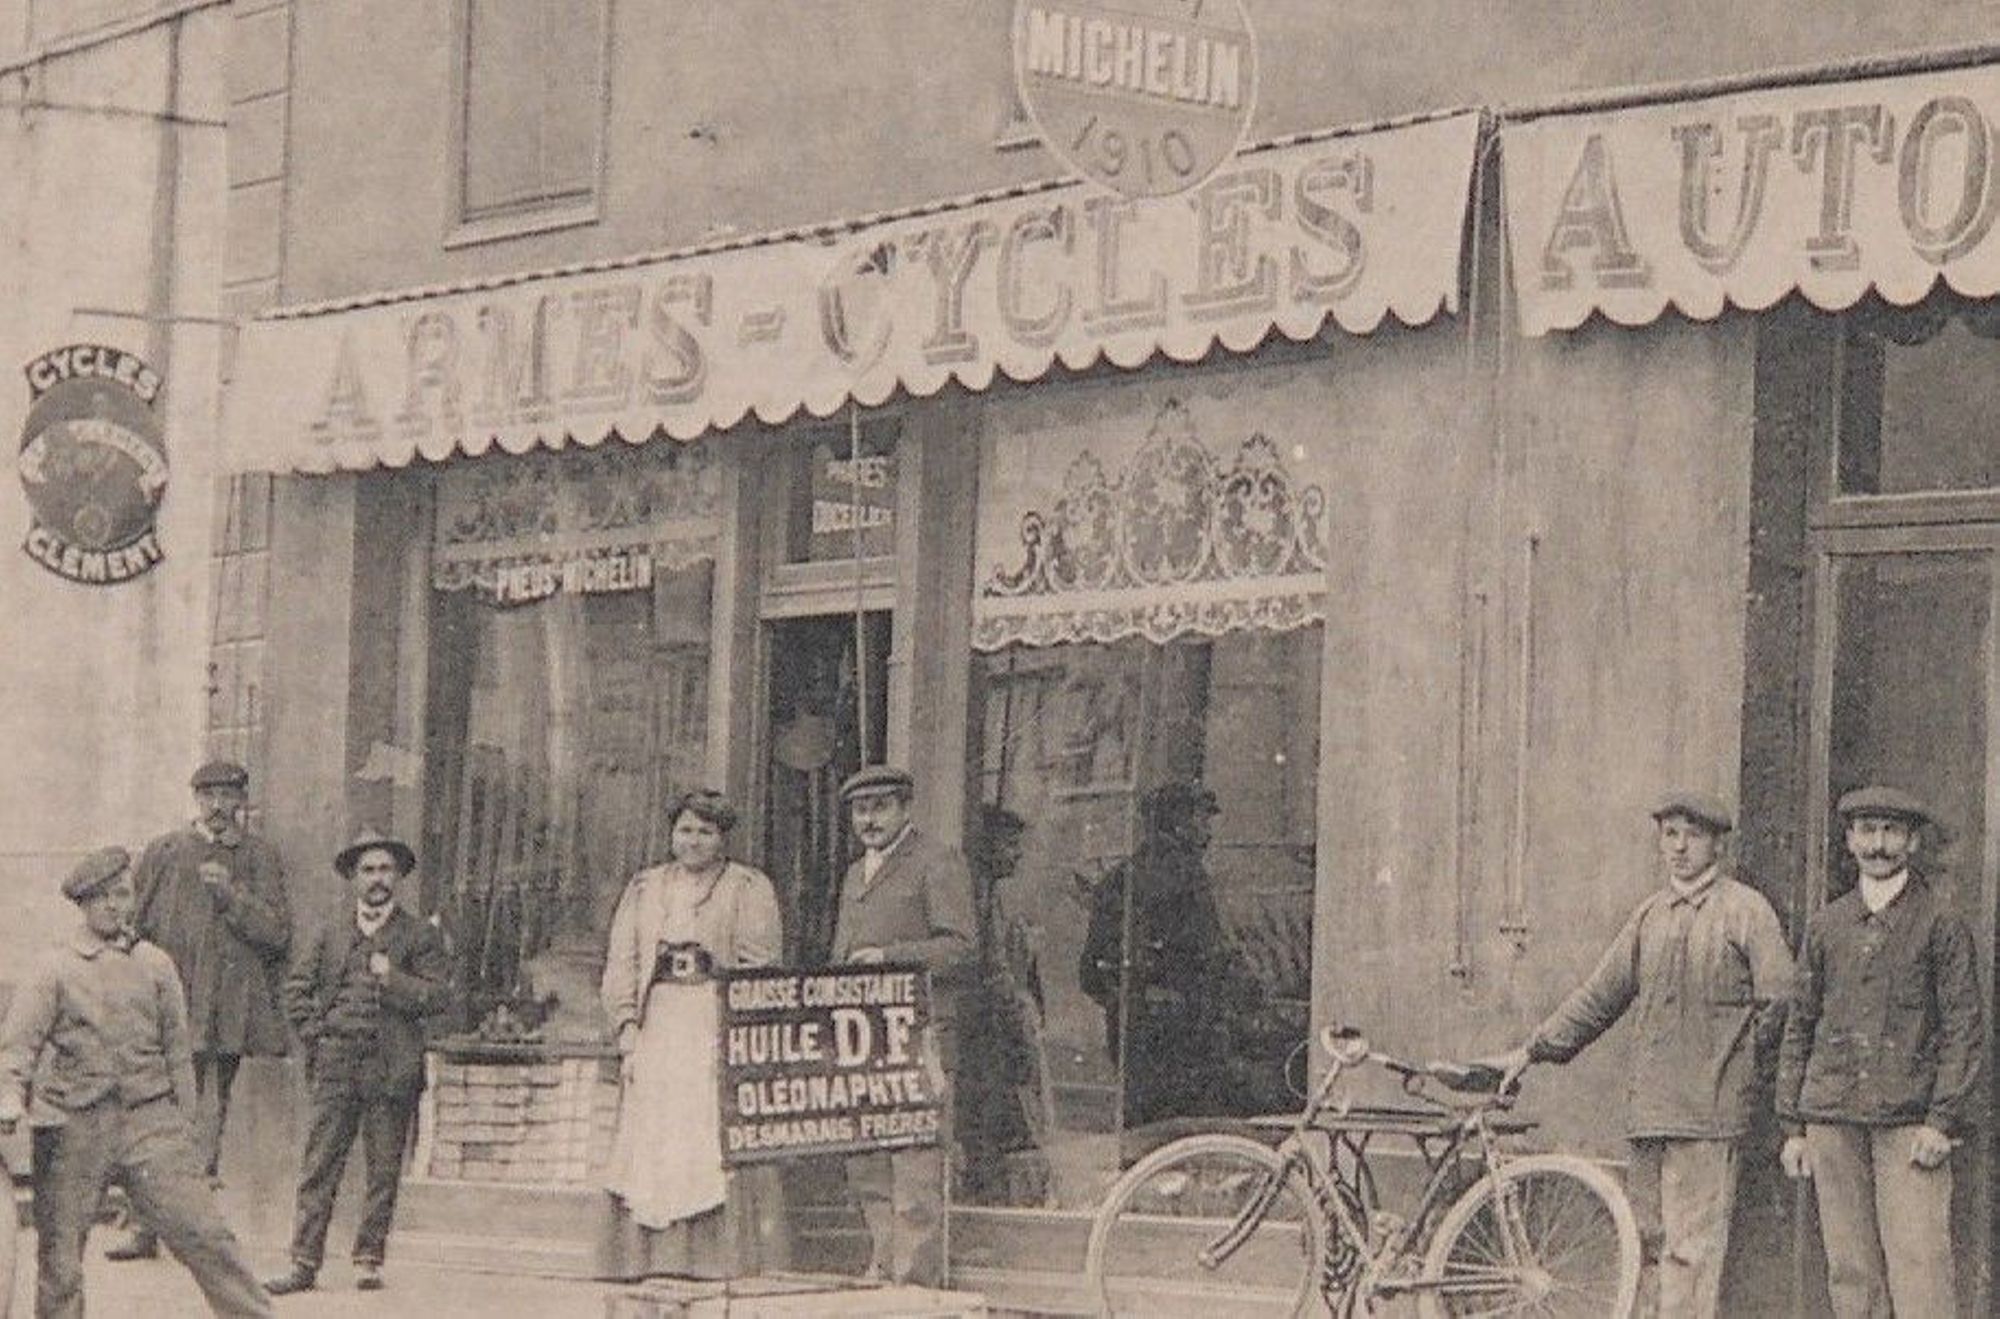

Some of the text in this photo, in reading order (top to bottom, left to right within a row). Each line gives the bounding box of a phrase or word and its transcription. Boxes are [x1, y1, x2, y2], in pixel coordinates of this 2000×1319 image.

[1027, 8, 1241, 109] MICHELIN
[1071, 115, 1196, 187] 1910
[817, 152, 1374, 384] CYCLES
[28, 347, 159, 401] CYCLES
[563, 555, 651, 592] MICHELIN
[728, 972, 916, 1011] GRAISSE CONSISTANTE
[728, 1022, 823, 1066] HUILE
[728, 1117, 855, 1151] DESMARAIS
